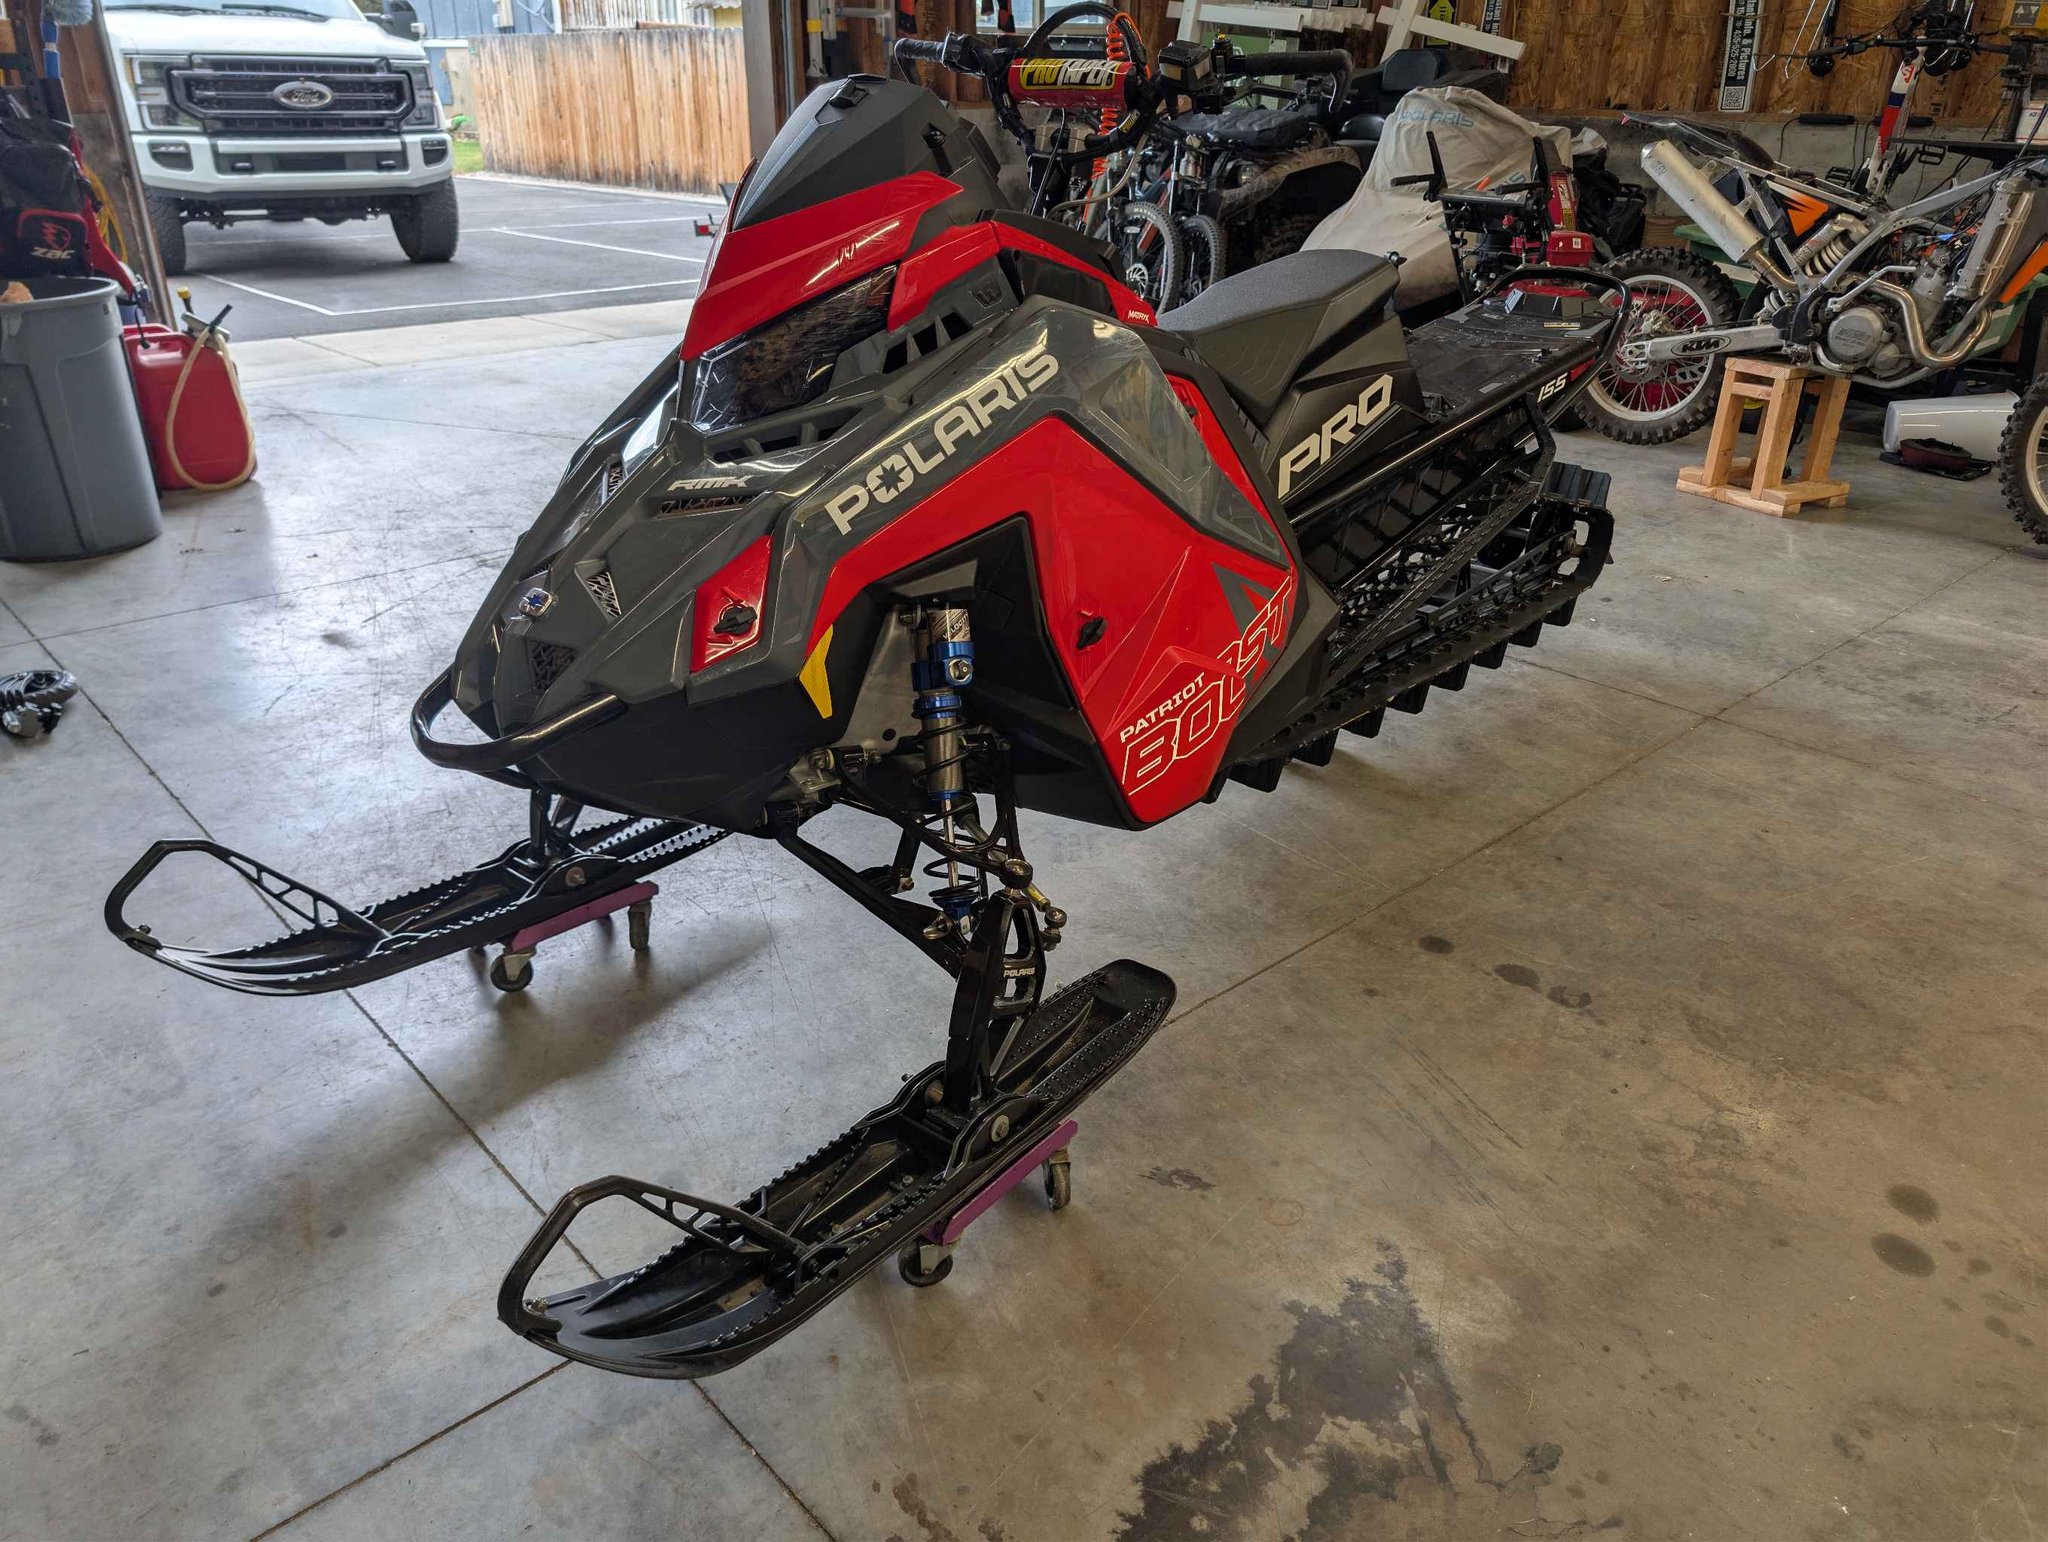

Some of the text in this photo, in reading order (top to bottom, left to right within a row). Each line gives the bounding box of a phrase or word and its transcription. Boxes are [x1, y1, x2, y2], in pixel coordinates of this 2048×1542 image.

[1737, 47, 1750, 80] Pictures
[291, 88, 320, 103] Ford
[1680, 338, 1722, 353] KTM
[1537, 372, 1568, 403] 155
[824, 354, 1059, 536] POLARIS
[1278, 374, 1393, 499] PRO
[667, 475, 755, 491] RMK
[1120, 672, 1205, 743] PATRIOT
